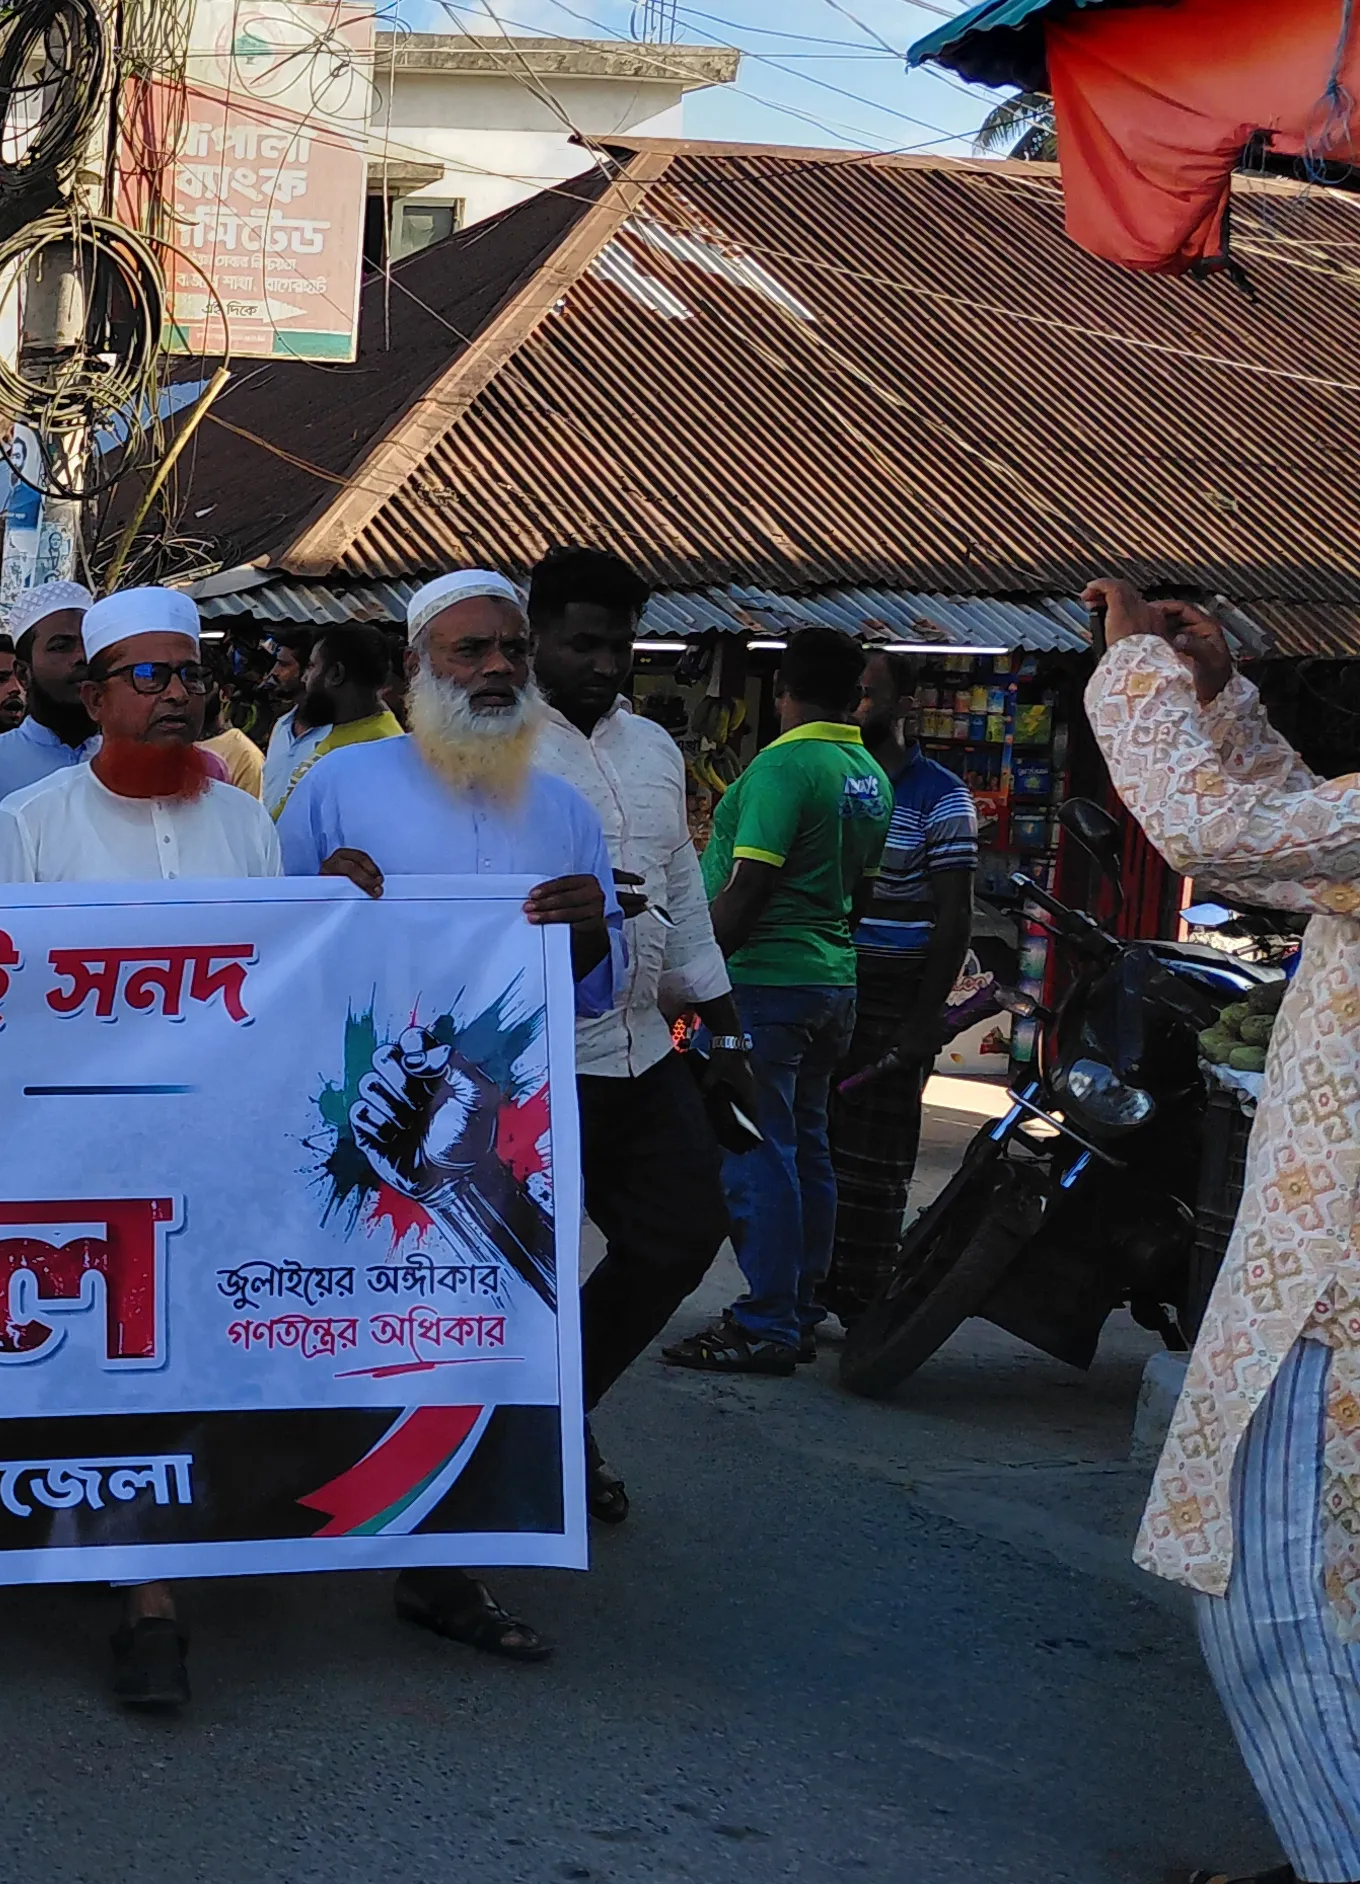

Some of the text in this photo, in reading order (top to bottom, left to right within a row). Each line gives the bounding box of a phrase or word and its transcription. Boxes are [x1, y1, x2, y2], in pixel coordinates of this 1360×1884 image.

[170, 163, 307, 203] ব্যাংক
[225, 300, 259, 316] দিকে
[48, 943, 256, 1024] সনদ
[217, 1253, 501, 1308] জুলাইয়ের অঙ্গীকার
[228, 1306, 507, 1360] গণতন্ত্রের অধিকার
